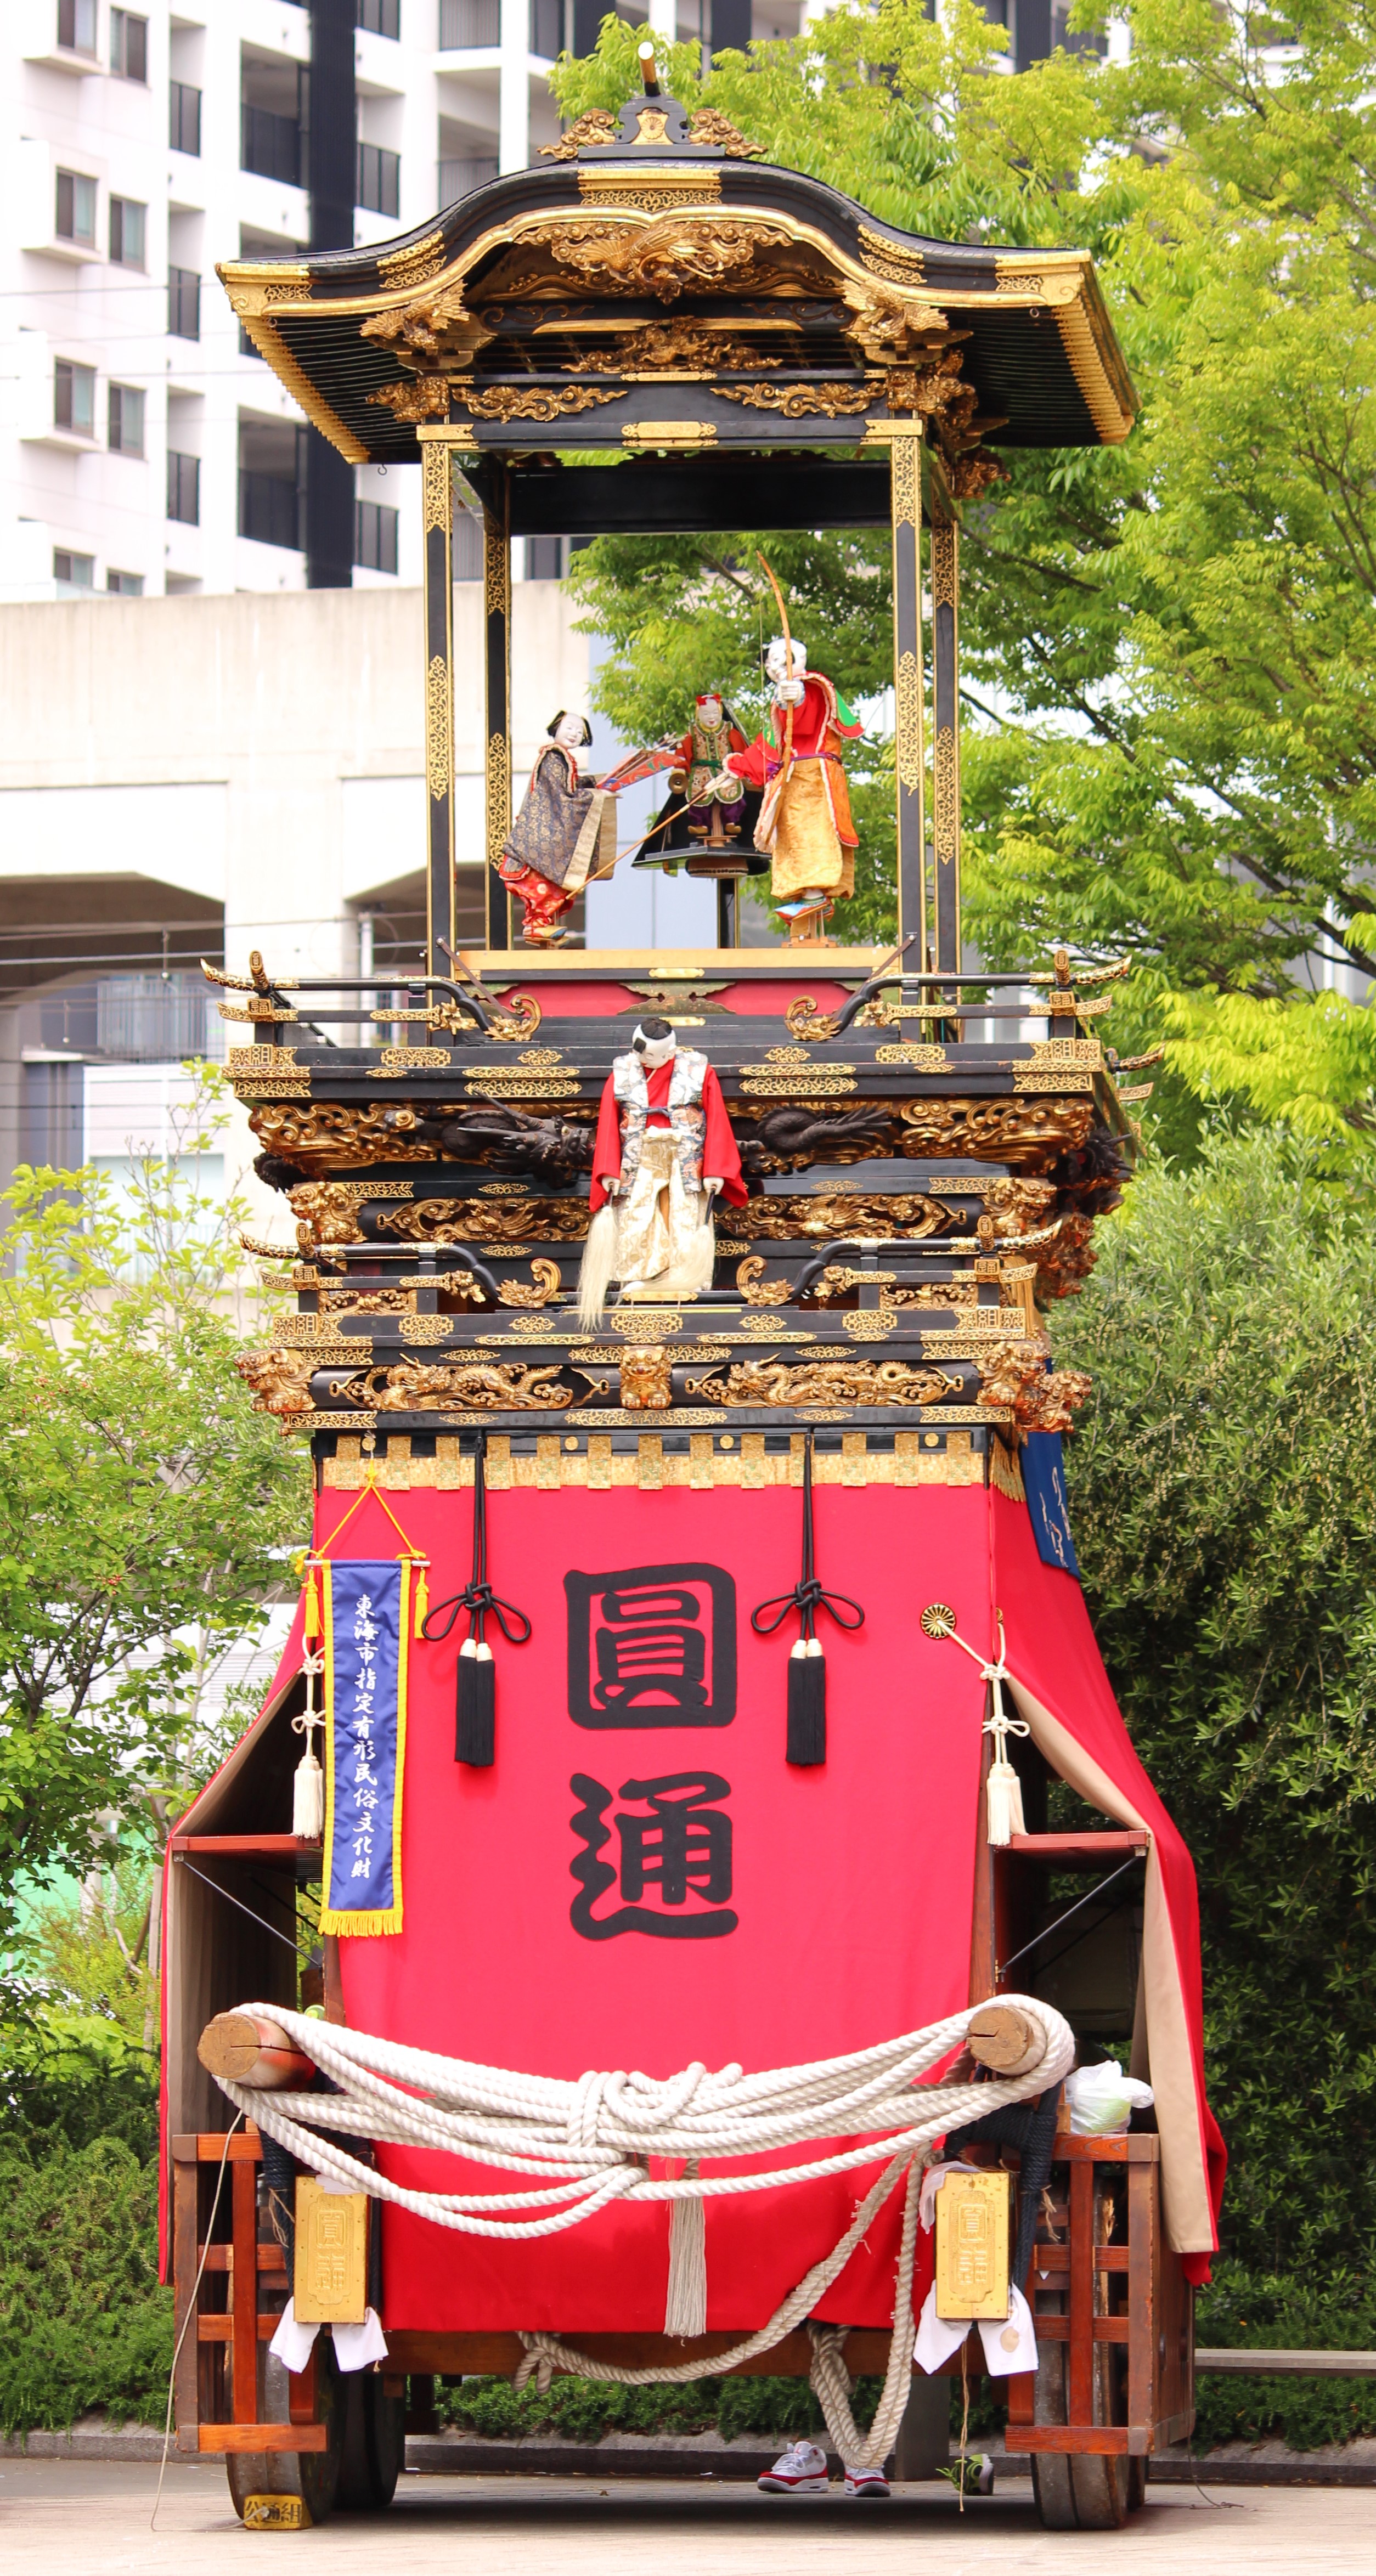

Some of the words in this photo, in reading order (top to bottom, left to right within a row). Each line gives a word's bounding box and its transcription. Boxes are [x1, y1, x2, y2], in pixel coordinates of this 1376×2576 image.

[350, 1594, 380, 1879] 東海市指定有形民俗文化財
[563, 1562, 738, 1941] 圓通
